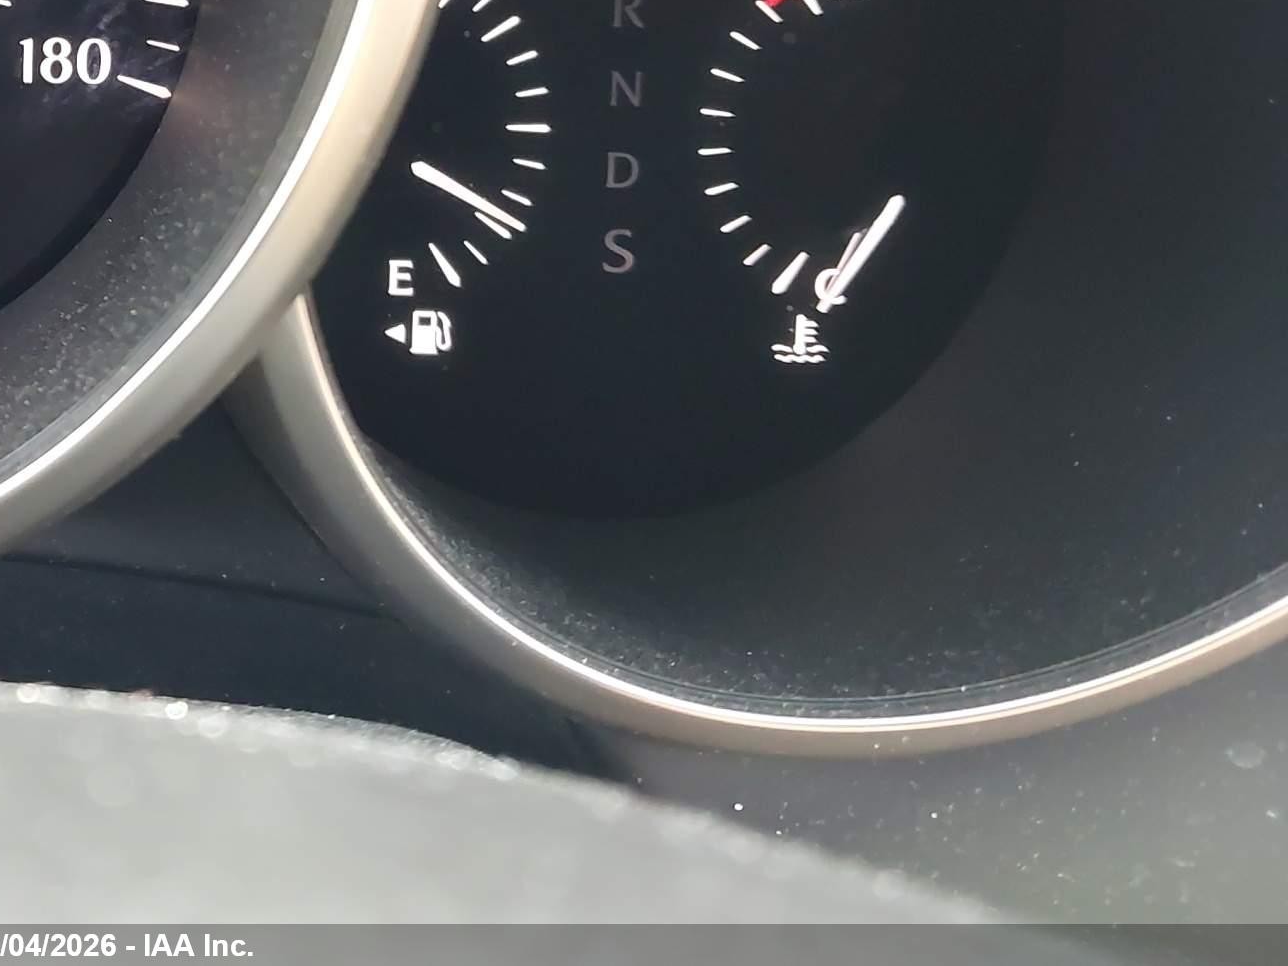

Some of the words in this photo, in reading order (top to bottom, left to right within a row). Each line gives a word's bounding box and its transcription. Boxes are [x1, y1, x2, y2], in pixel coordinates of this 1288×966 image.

[19, 36, 112, 85] 180
[610, 70, 643, 107] N
[605, 151, 640, 189] D
[602, 229, 635, 273] S
[387, 259, 414, 297] E
